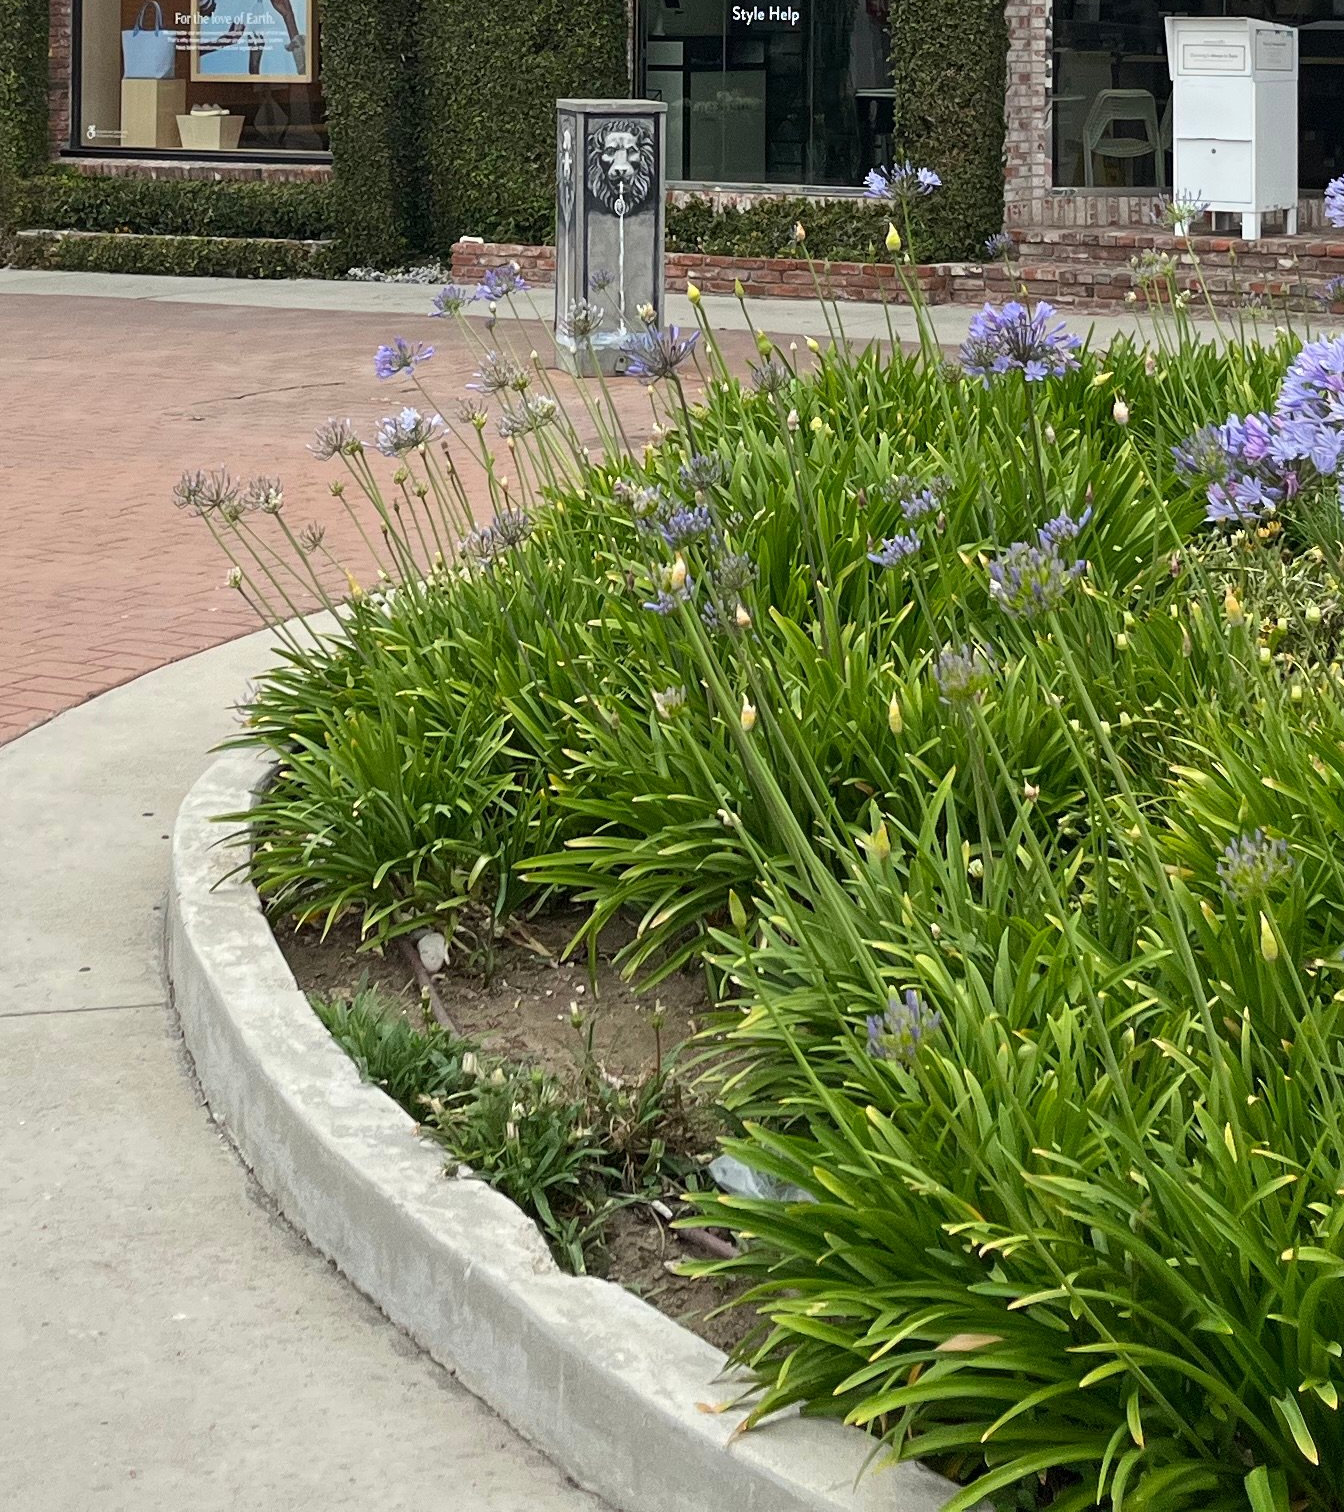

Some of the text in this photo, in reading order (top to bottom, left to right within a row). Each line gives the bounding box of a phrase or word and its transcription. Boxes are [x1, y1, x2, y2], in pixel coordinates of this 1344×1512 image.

[175, 11, 276, 25] For the love of Earth.
[732, 6, 800, 26] Style Help
